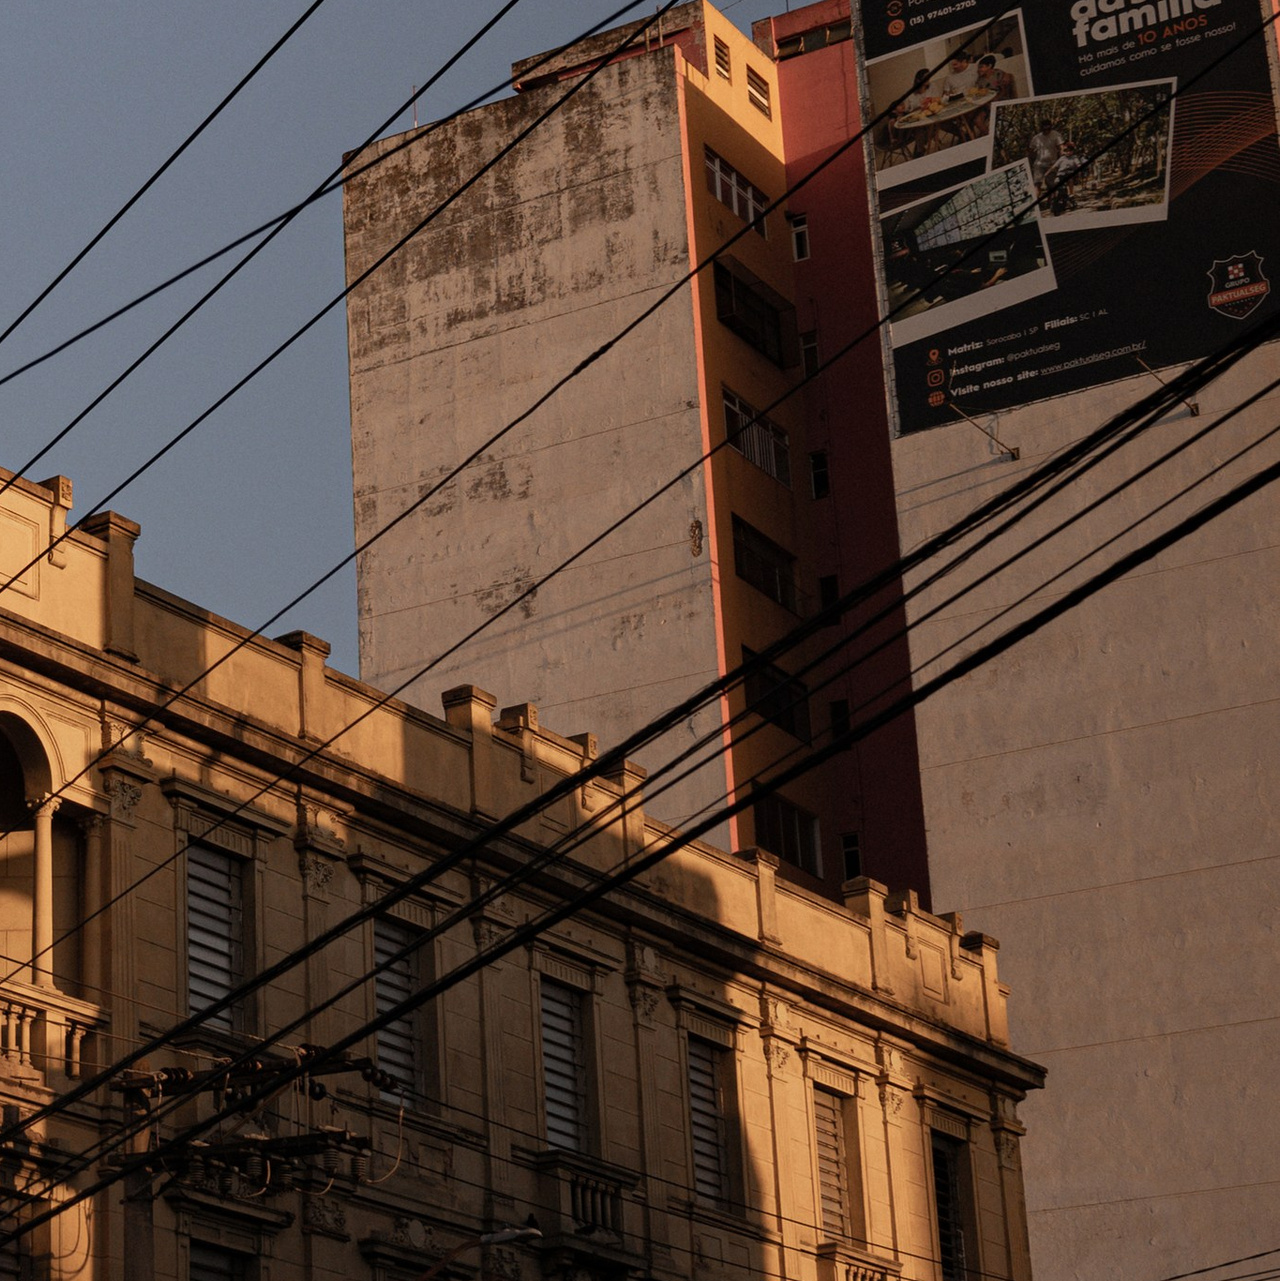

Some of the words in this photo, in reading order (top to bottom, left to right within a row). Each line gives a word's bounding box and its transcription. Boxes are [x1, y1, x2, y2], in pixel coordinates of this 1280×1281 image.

[909, 14, 925, 27] (15)
[1078, 52, 1094, 64] Há
[1096, 45, 1119, 59] mais
[1122, 39, 1136, 51] de
[1137, 30, 1158, 46] 10
[1162, 14, 1209, 39] ANOS
[1079, 55, 1127, 77] cuidamos
[1129, 47, 1158, 62] como
[1160, 42, 1173, 53] se
[1175, 34, 1202, 48] fosse
[1204, 21, 1237, 39] nosso!
[1211, 283, 1267, 305] PAKTUALSEG
[947, 340, 984, 357] Matriz:
[986, 331, 1022, 347] Sorocaba
[1028, 325, 1039, 336] SP
[1044, 315, 1079, 331] Filiais:
[1079, 311, 1091, 322] SC
[1097, 307, 1109, 317] AL
[949, 356, 1005, 378] Instagram:
[1006, 340, 1061, 363] @paktualseg
[950, 383, 980, 398] Visite
[983, 375, 1014, 390] nosso
[1017, 368, 1039, 383] site:
[1040, 339, 1148, 377] www.paktualseg.com.br/
